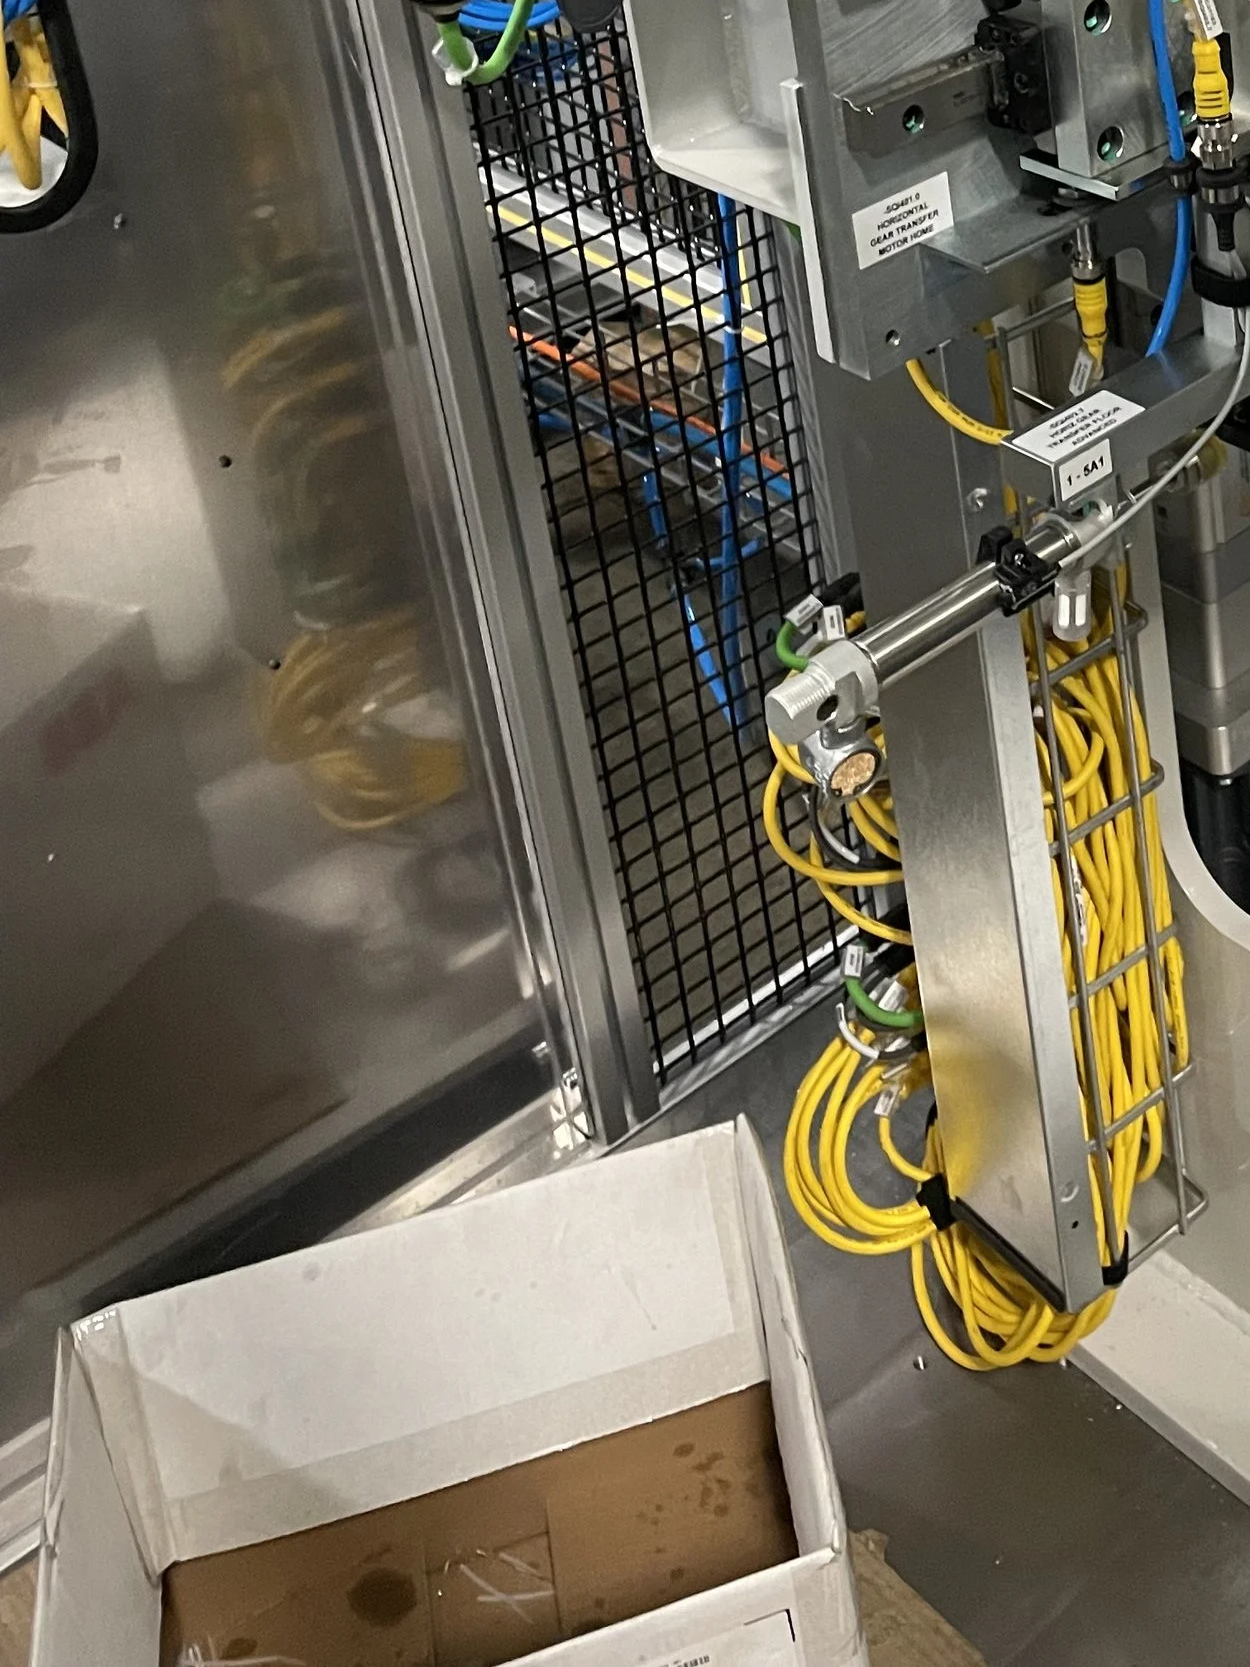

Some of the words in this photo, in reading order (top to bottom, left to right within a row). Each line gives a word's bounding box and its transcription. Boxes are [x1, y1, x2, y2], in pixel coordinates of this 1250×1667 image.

[870, 230, 894, 247] GEAR
[895, 209, 939, 235] TRANSFER
[877, 202, 928, 231] HORIZONTAL
[878, 236, 908, 255] MOTOR
[910, 223, 934, 241] HOME
[1075, 408, 1100, 423] GEAR
[1047, 423, 1091, 448] TRANSFER
[1071, 418, 1117, 446] ADVANCED
[1066, 474, 1073, 487] 1
